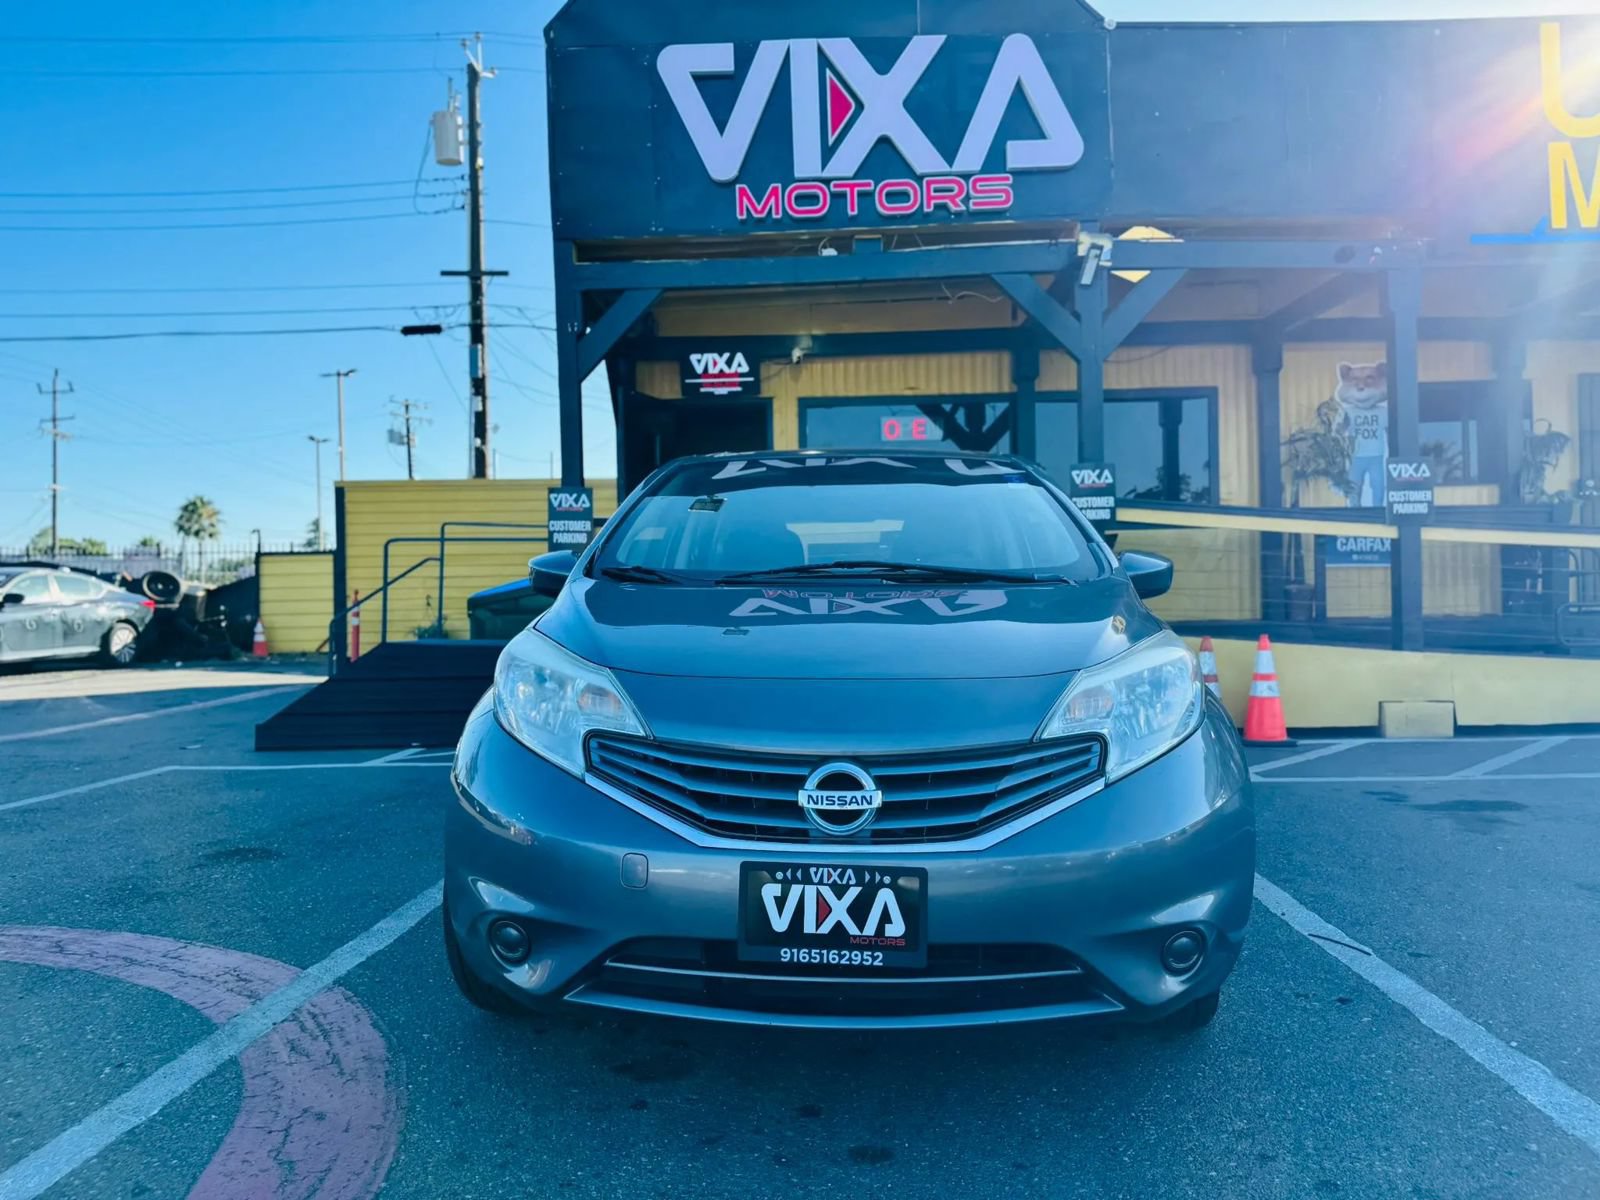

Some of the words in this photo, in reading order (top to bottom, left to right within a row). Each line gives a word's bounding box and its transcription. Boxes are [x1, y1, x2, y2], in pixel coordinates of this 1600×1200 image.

[656, 33, 1085, 183] VIXA
[735, 174, 1014, 219] MOTORS
[689, 352, 750, 375] VIXA
[1354, 414, 1379, 427] CAR
[1354, 428, 1378, 440] FOX
[1071, 469, 1114, 485] VIXA
[1388, 463, 1431, 478] VIXA
[549, 493, 591, 508] VIXA
[1388, 490, 1432, 502] CUSTOMER
[1393, 502, 1429, 515] PARKING
[549, 520, 592, 531] CUSTOMER
[553, 532, 588, 544] PARKING
[1336, 536, 1392, 552] CARFAX
[807, 794, 873, 806] NISSAN
[809, 867, 857, 885] VIXA
[761, 883, 906, 938] VIXA
[850, 936, 906, 946] MOTORS
[780, 947, 884, 966] 9165162952
